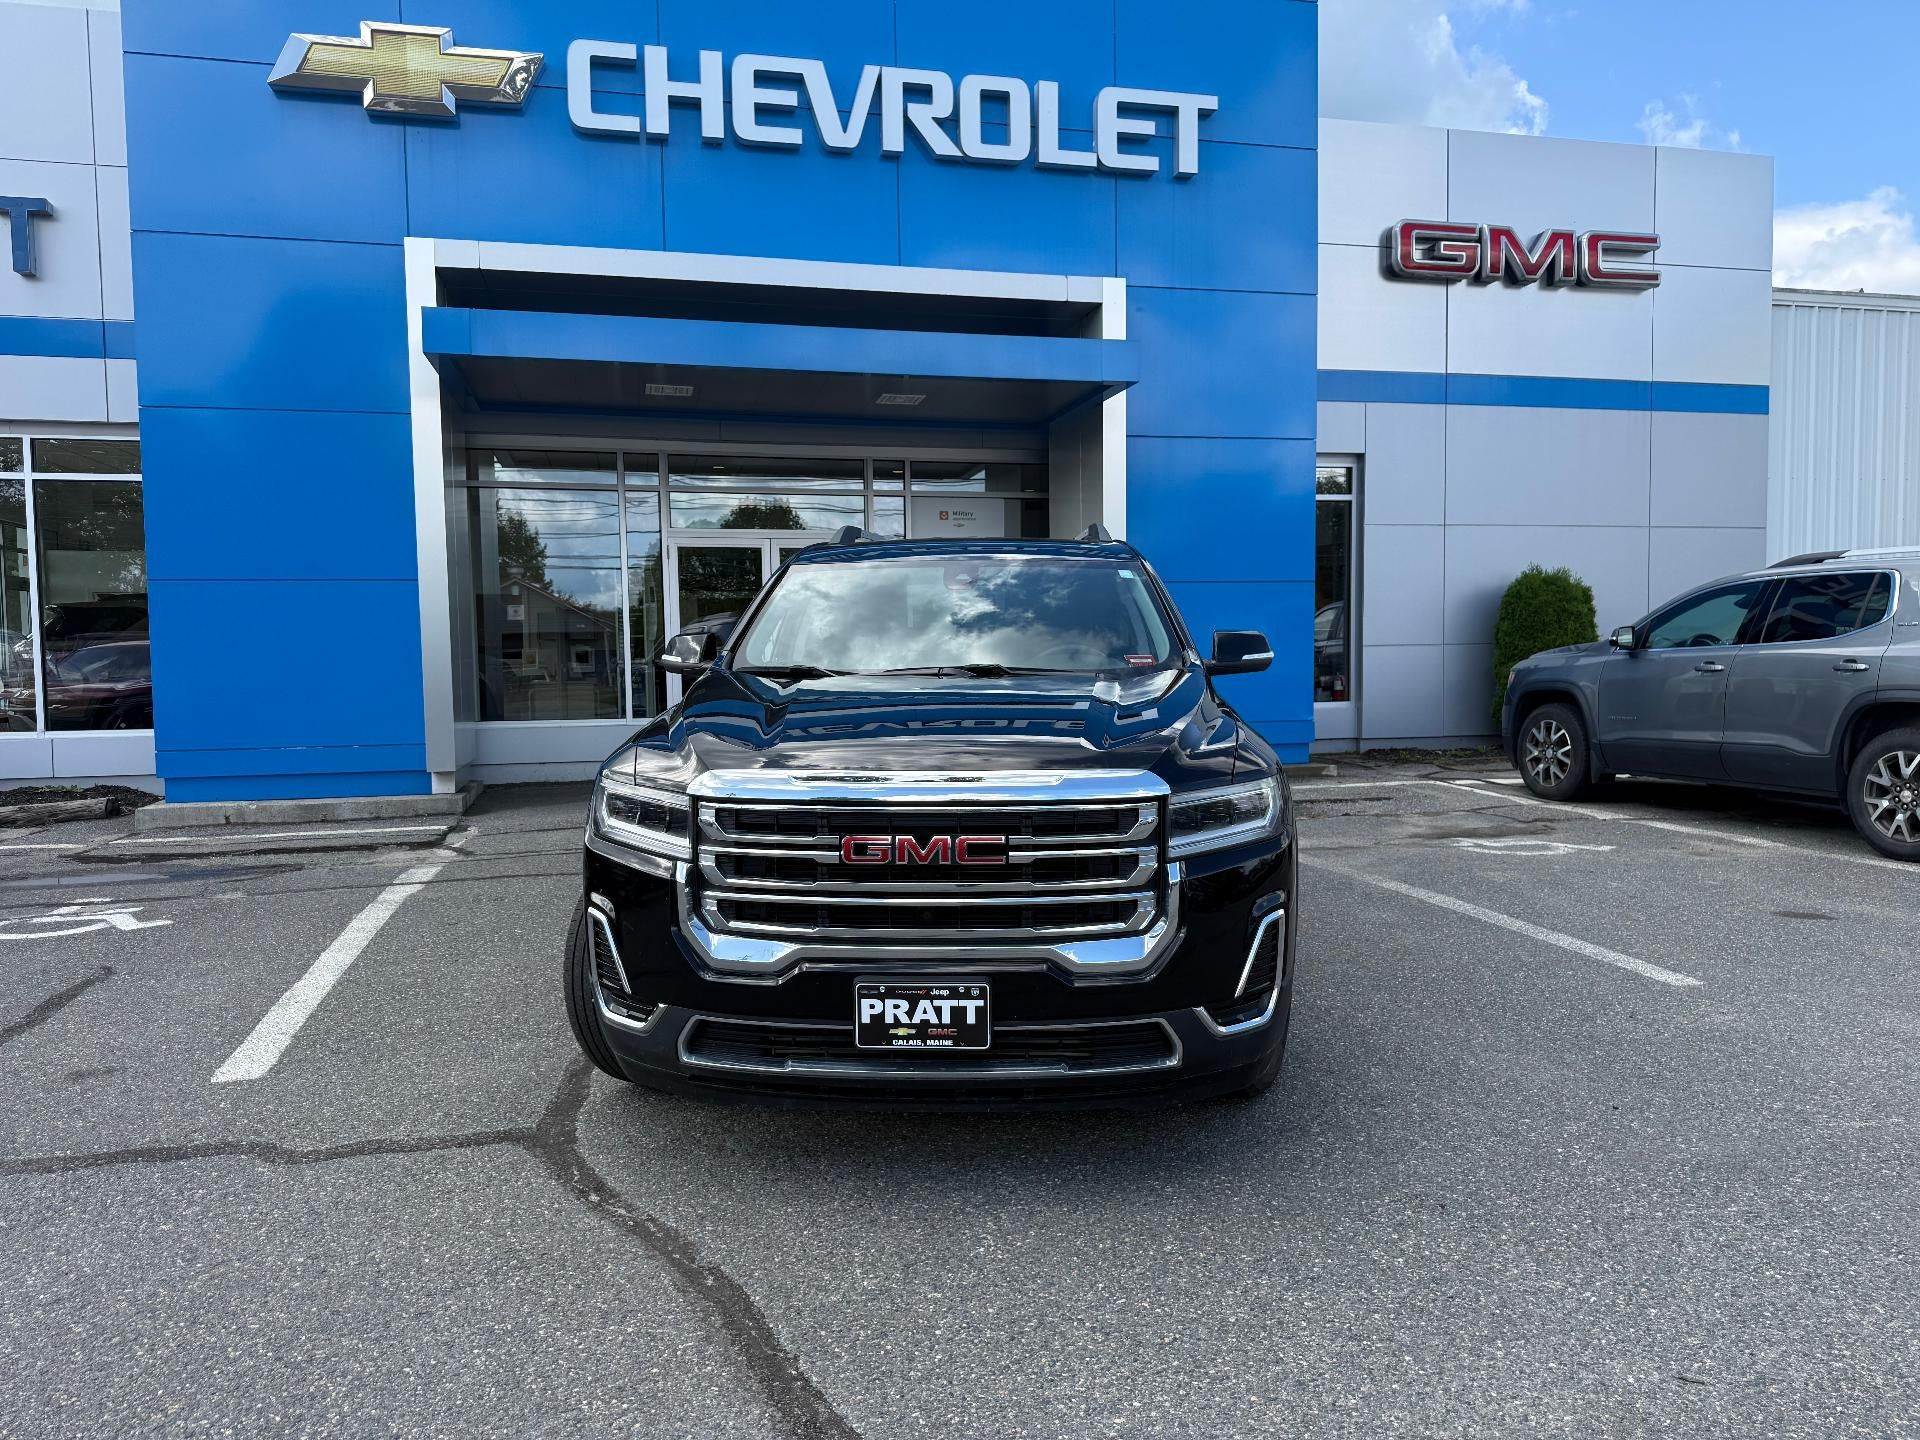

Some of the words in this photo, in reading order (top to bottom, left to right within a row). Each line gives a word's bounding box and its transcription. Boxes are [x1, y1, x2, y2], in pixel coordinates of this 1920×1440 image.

[566, 38, 1220, 179] CHEVROLET
[1388, 218, 1661, 289] GMC
[841, 835, 1007, 865] GMC
[930, 988, 950, 997] Jeep
[860, 998, 985, 1025] PRATT
[892, 1039, 924, 1047] CALAIS,
[927, 1028, 958, 1036] GMC
